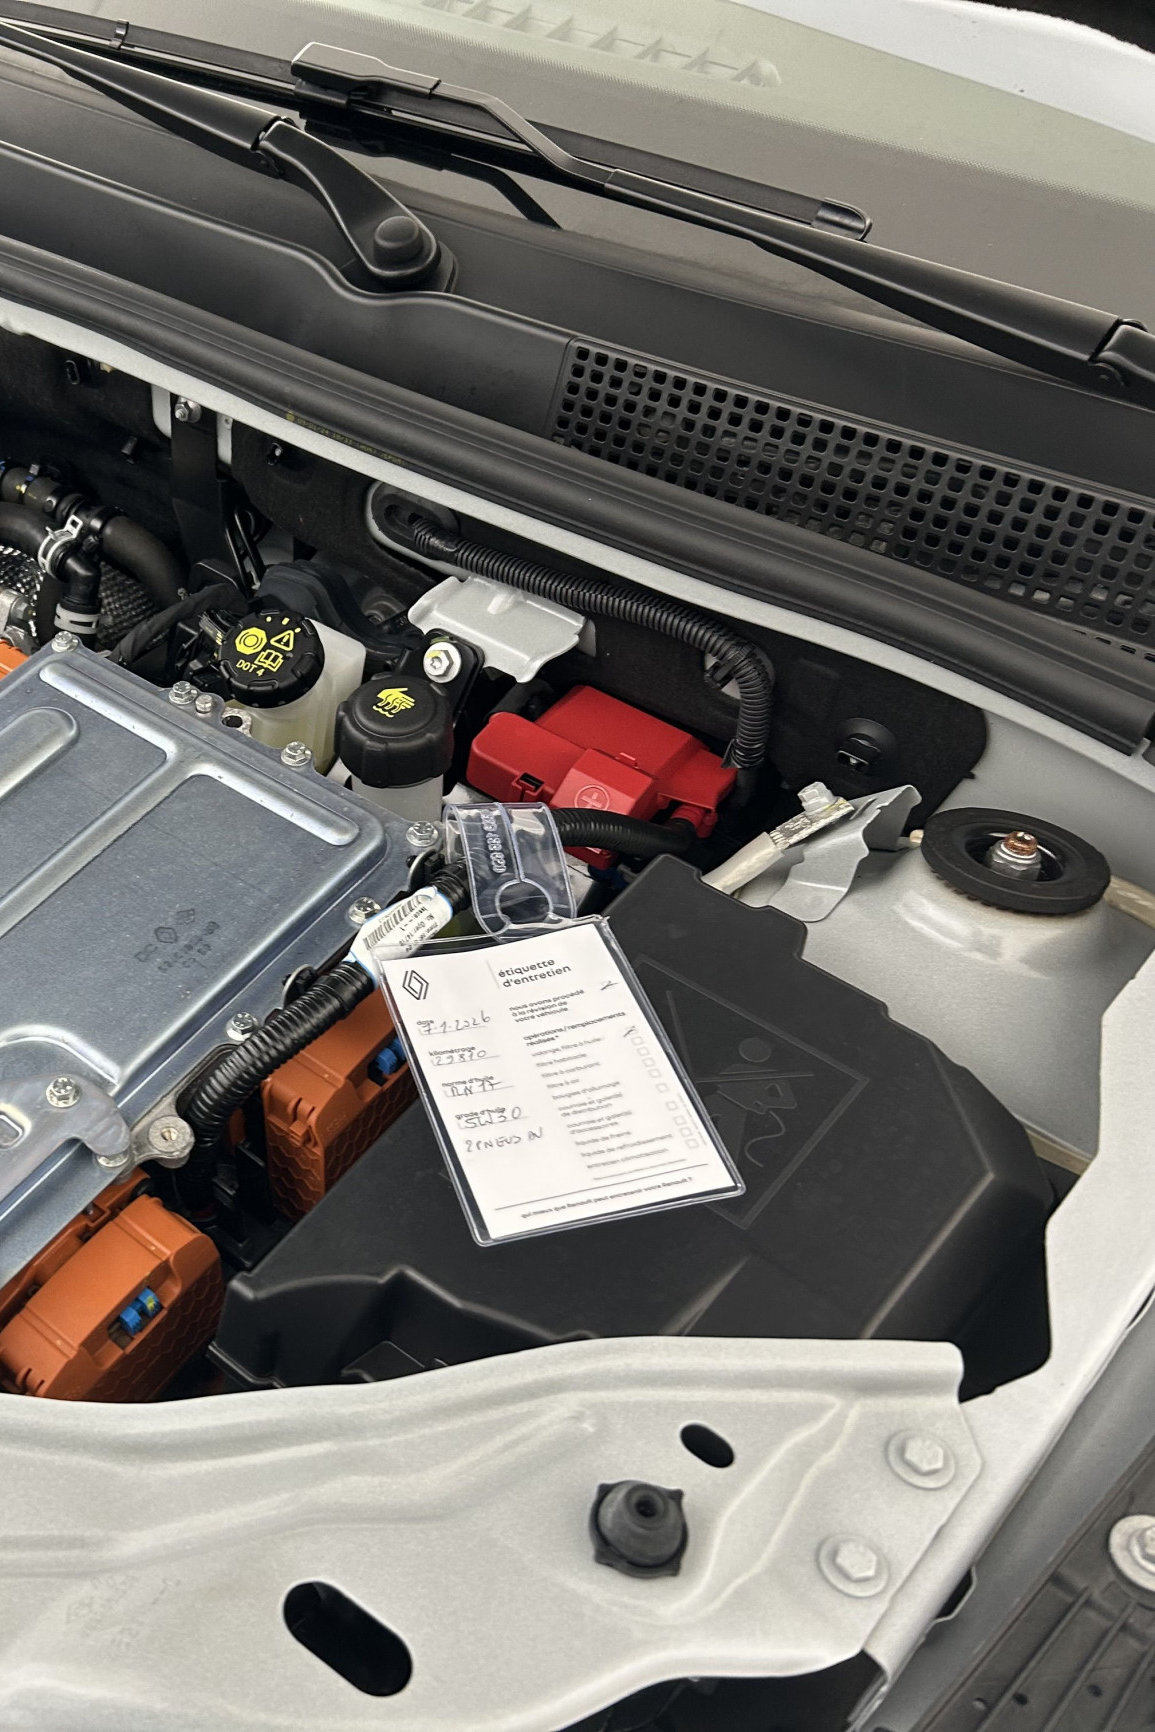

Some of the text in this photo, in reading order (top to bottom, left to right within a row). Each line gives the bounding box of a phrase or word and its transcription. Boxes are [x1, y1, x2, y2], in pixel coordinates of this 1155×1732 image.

[236, 659, 265, 676] DOT 4
[498, 959, 555, 978] étiquette
[503, 966, 571, 987] d'entretien
